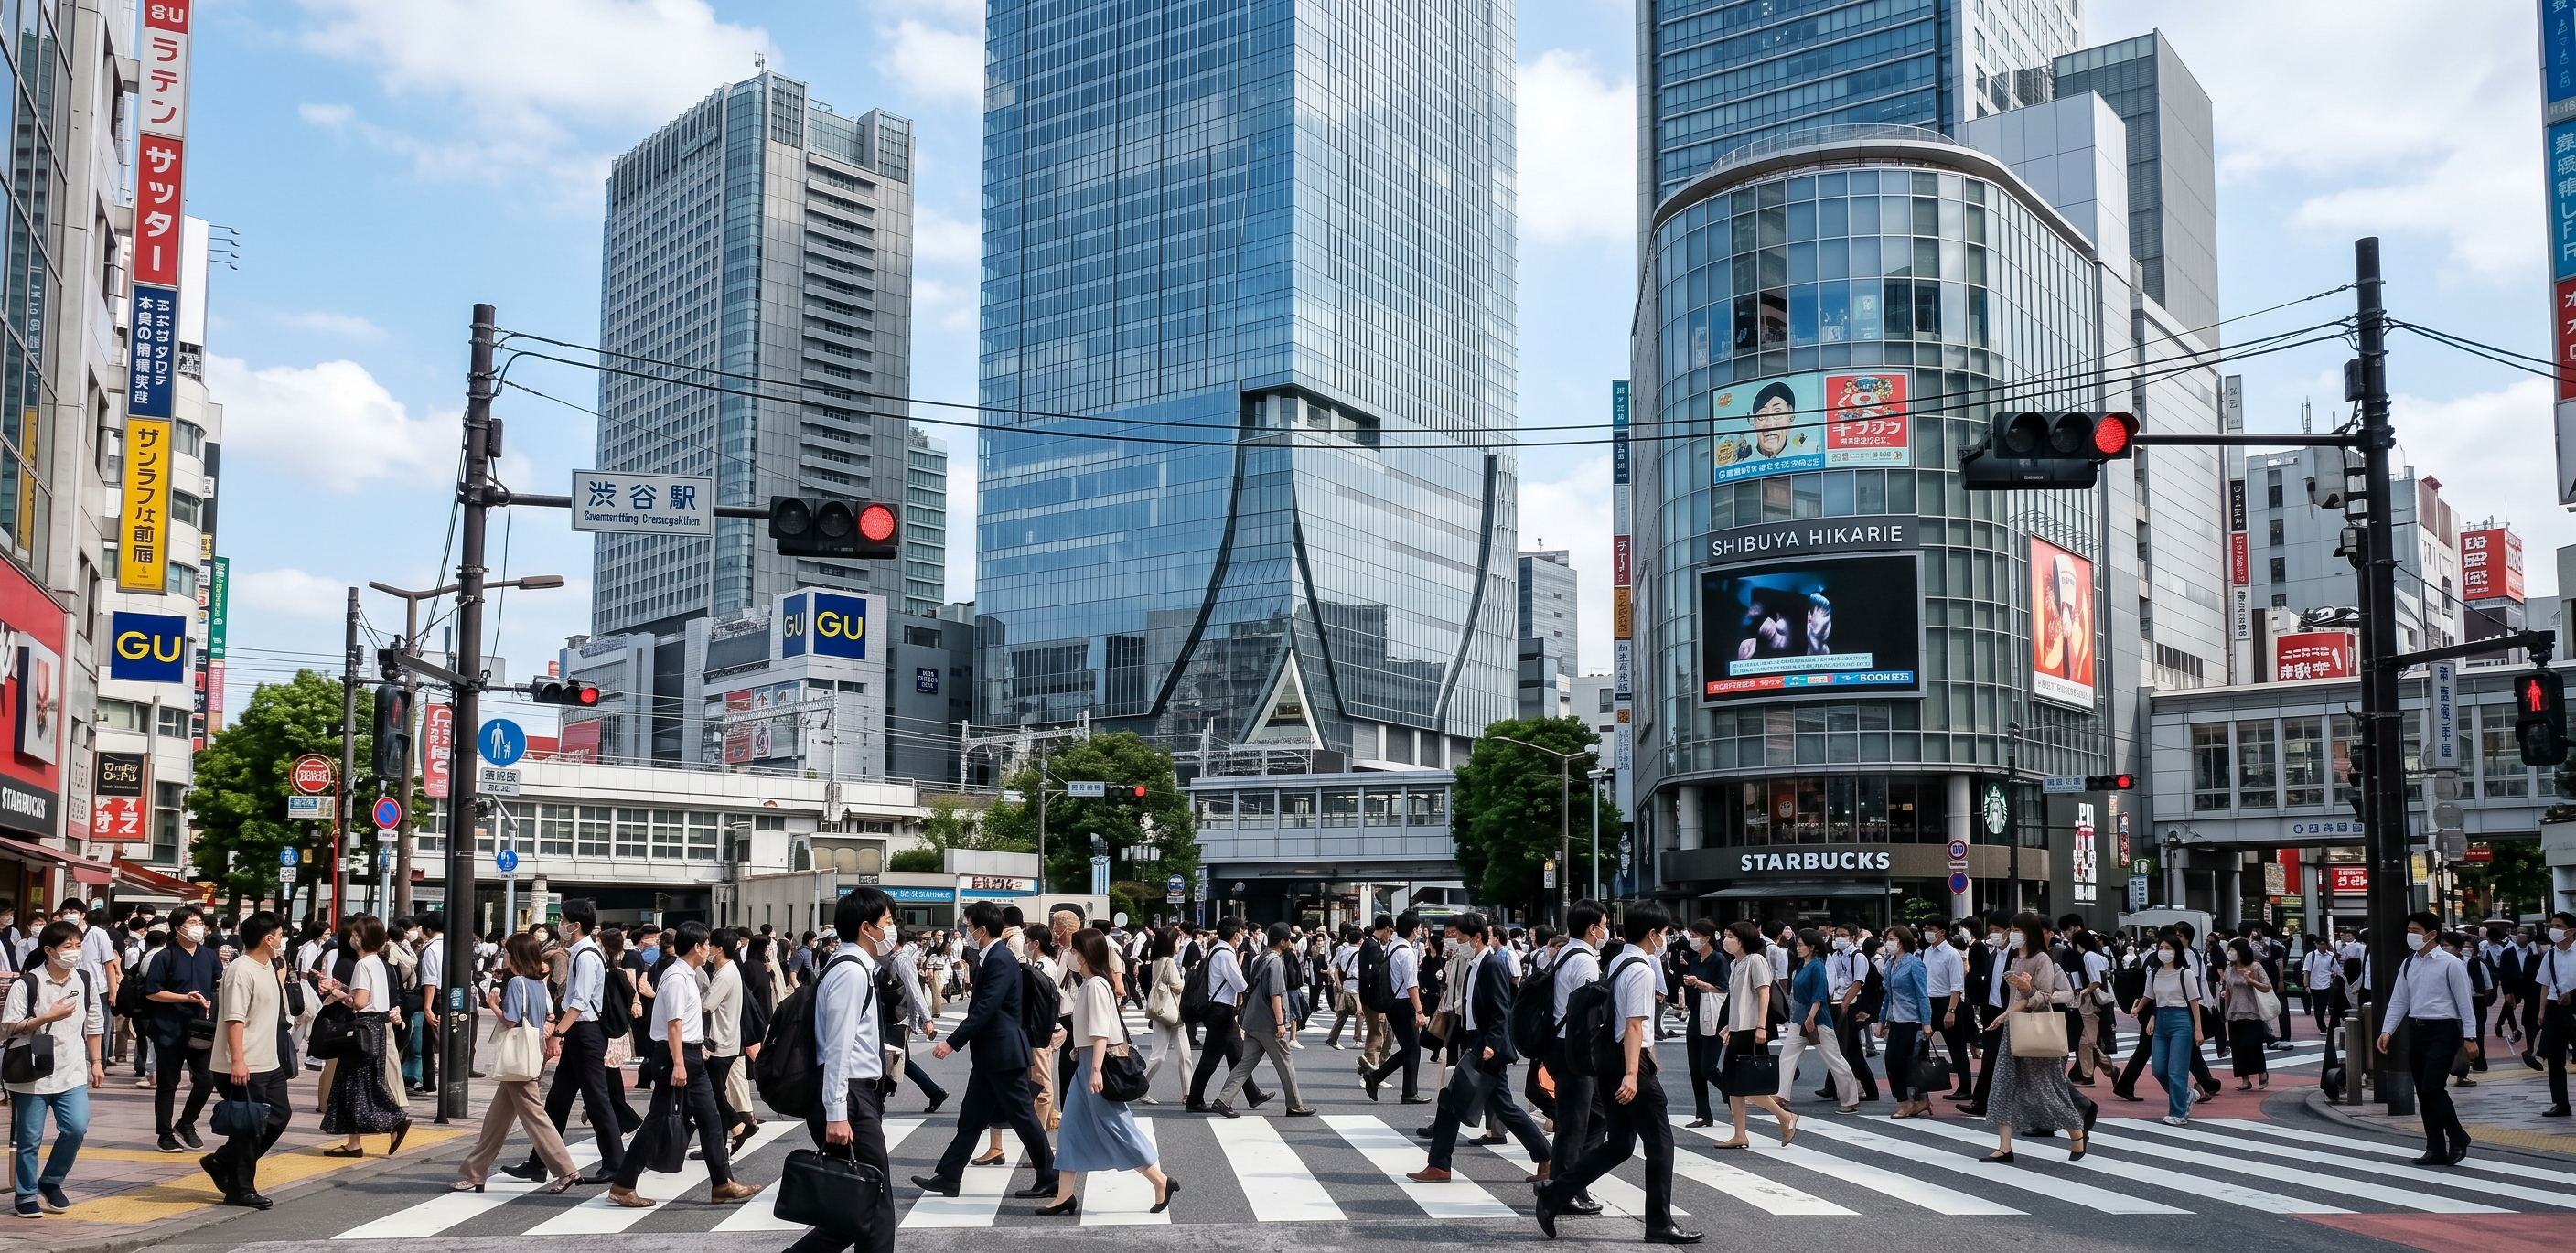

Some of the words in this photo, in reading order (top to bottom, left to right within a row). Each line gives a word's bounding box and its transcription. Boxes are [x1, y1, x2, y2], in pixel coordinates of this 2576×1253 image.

[151, 37, 178, 123] ラテン
[144, 146, 176, 271] サッター
[588, 480, 696, 510] 渋谷駅
[1712, 531, 1800, 556] SHIBUYA
[1809, 525, 1903, 546] HIKARIE
[784, 612, 804, 637] GU
[817, 611, 864, 640] GU
[116, 630, 181, 662] GU
[1741, 851, 1891, 872] STARBUCKS
